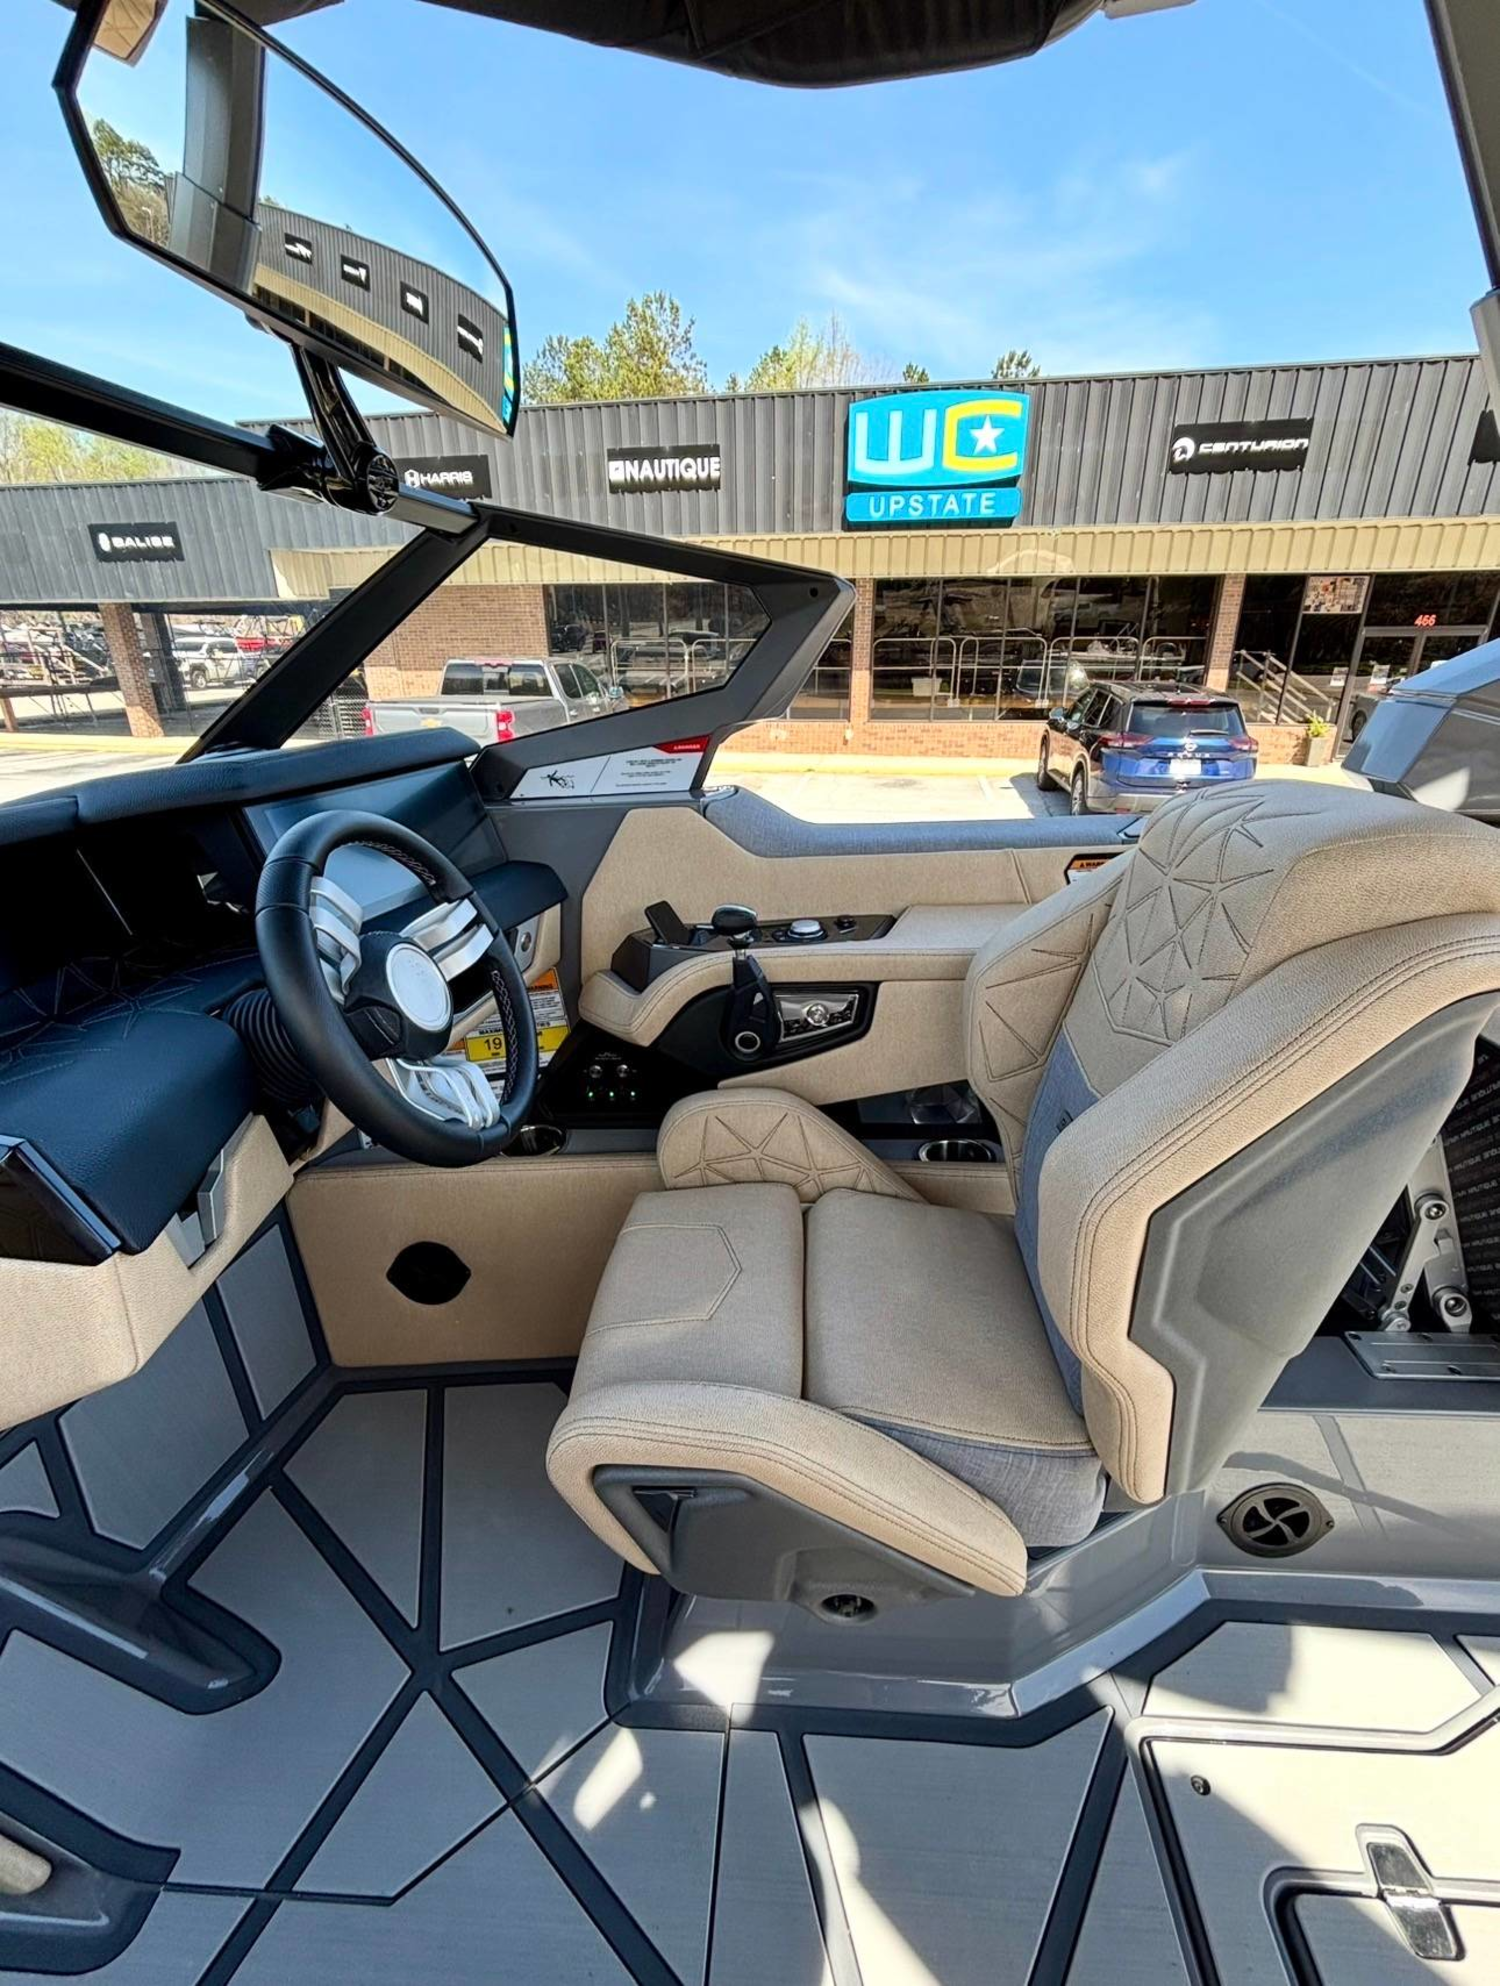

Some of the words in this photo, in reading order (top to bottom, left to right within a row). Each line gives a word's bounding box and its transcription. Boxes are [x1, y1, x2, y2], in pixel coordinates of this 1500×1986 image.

[1197, 438, 1309, 455] CENTURION
[420, 470, 474, 486] HARRIS
[624, 456, 721, 483] NAUTIQUE
[868, 491, 998, 519] UPSTATE
[484, 1037, 503, 1051] 19
